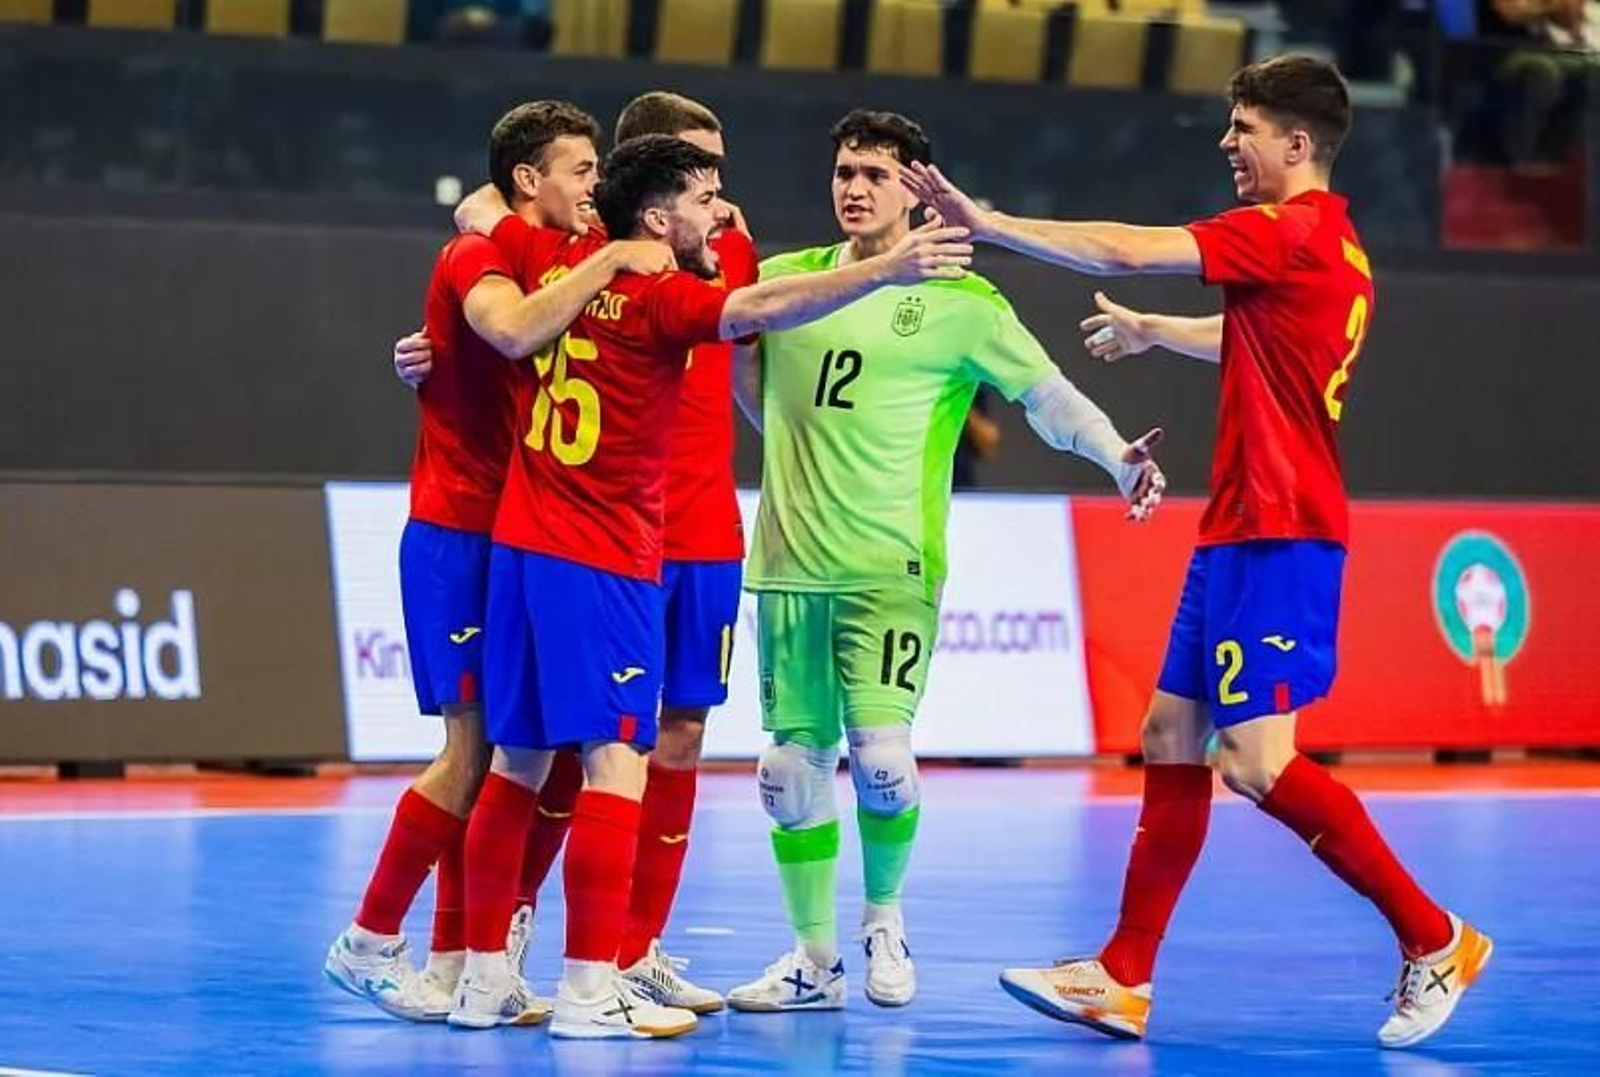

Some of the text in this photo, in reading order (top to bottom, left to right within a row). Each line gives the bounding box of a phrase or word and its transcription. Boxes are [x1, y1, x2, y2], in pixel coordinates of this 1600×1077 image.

[815, 348, 862, 409] 12
[1324, 294, 1367, 421] 2
[880, 628, 921, 693] 12
[1215, 640, 1249, 705] 2
